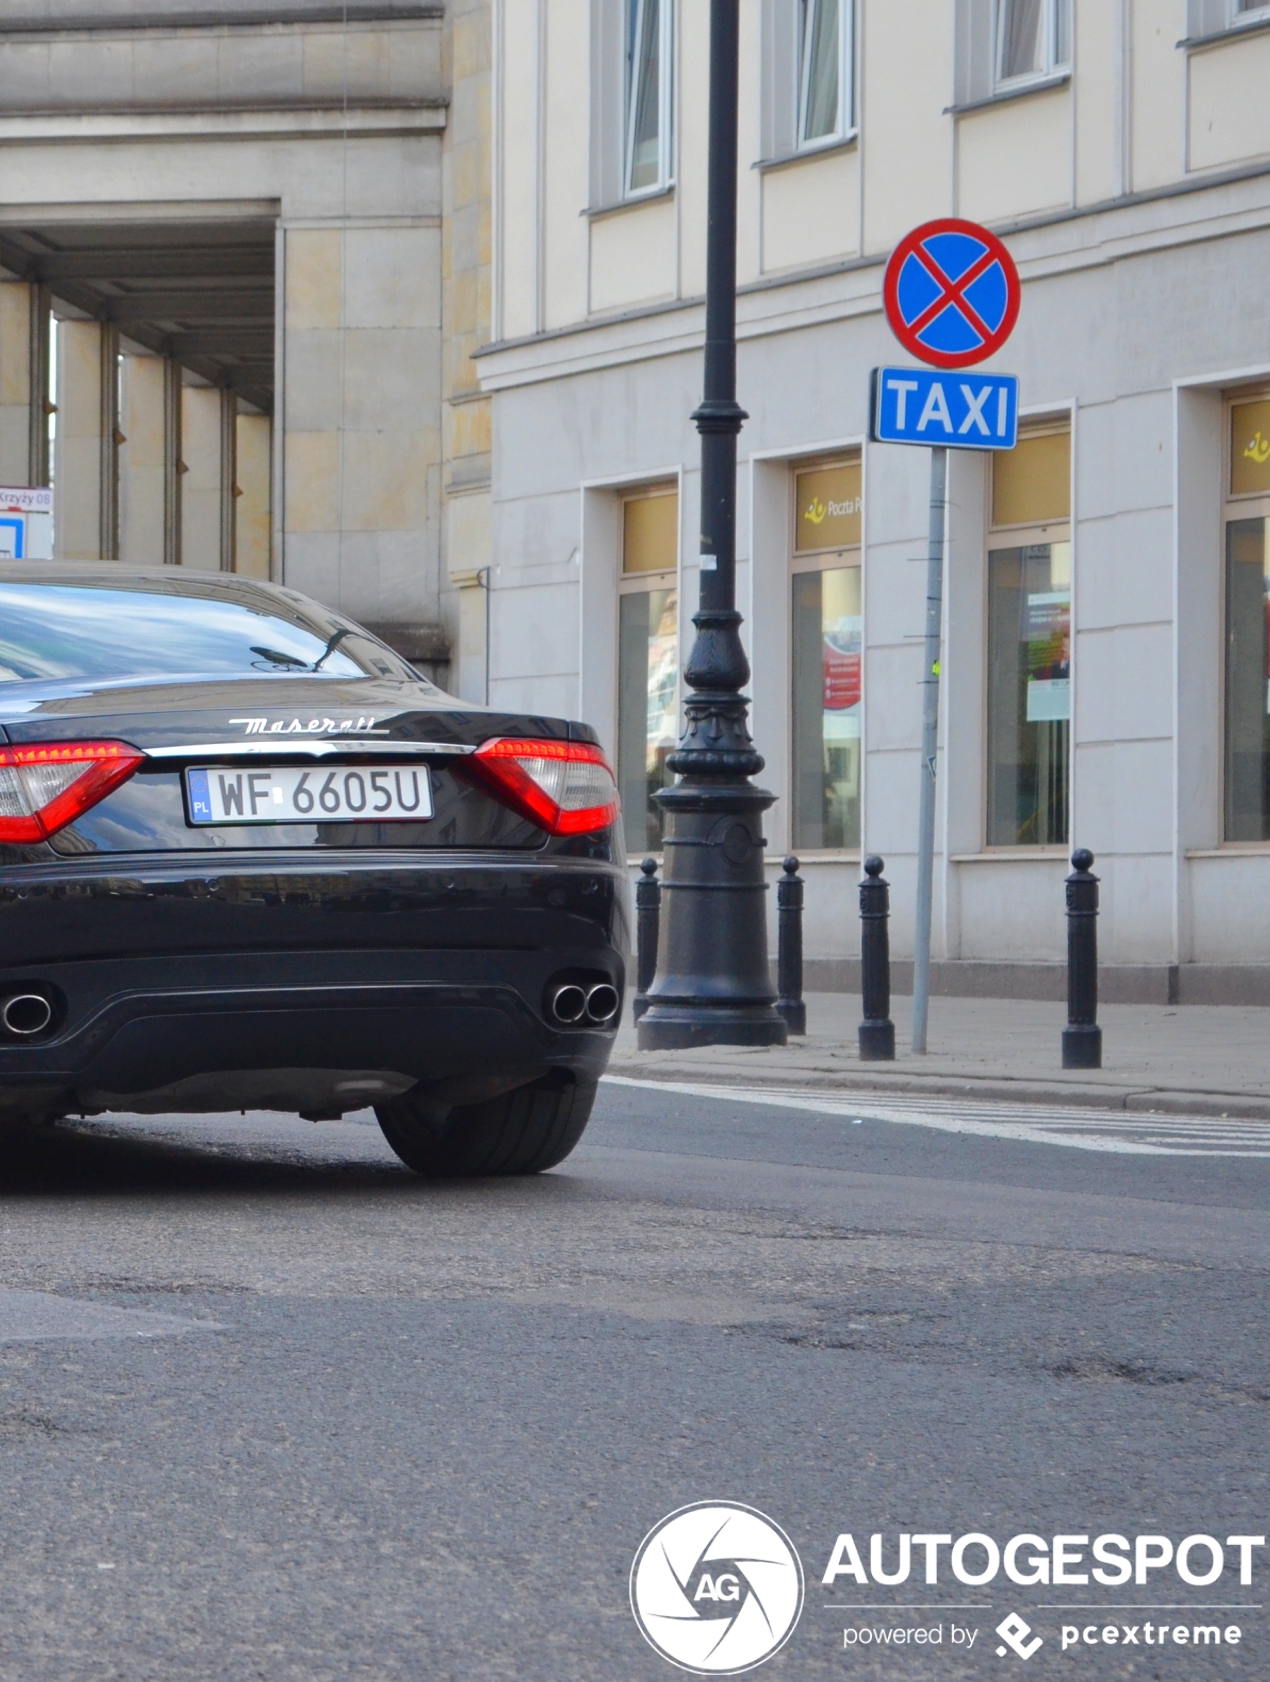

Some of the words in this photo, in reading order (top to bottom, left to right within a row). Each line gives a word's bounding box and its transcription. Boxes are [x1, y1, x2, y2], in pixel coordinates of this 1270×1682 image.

[887, 379, 1008, 437] TAXI
[36, 493, 50, 505] 08
[828, 500, 854, 516] Poczta
[229, 716, 390, 735] Maserati
[218, 774, 271, 815] WF
[293, 771, 420, 813] 6605U
[194, 802, 209, 813] PL
